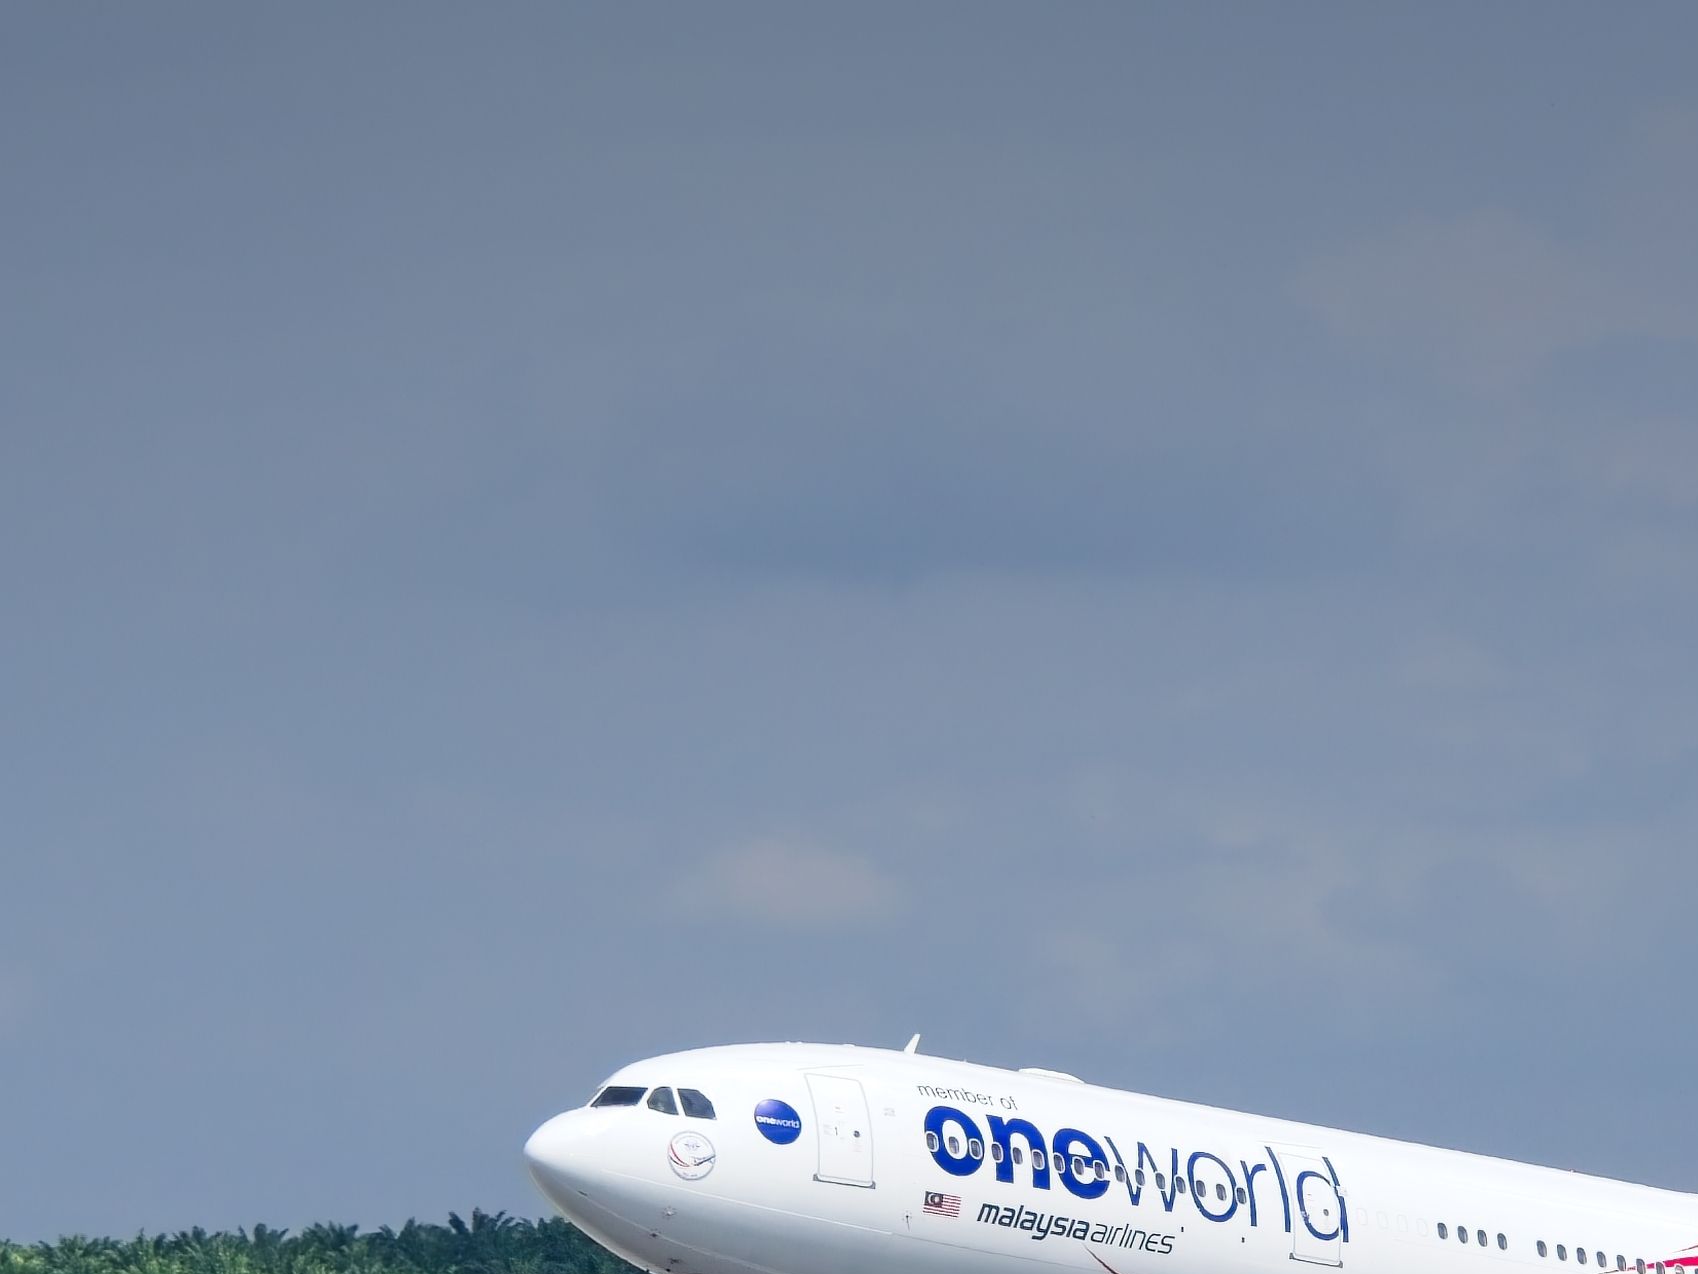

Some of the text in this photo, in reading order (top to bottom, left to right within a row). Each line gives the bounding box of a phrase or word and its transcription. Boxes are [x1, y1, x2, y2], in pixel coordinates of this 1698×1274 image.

[917, 1085, 1018, 1110] member of
[755, 1115, 800, 1129] oneworld
[924, 1105, 1349, 1243] oneworld
[977, 1203, 1176, 1254] malaysia airlines
